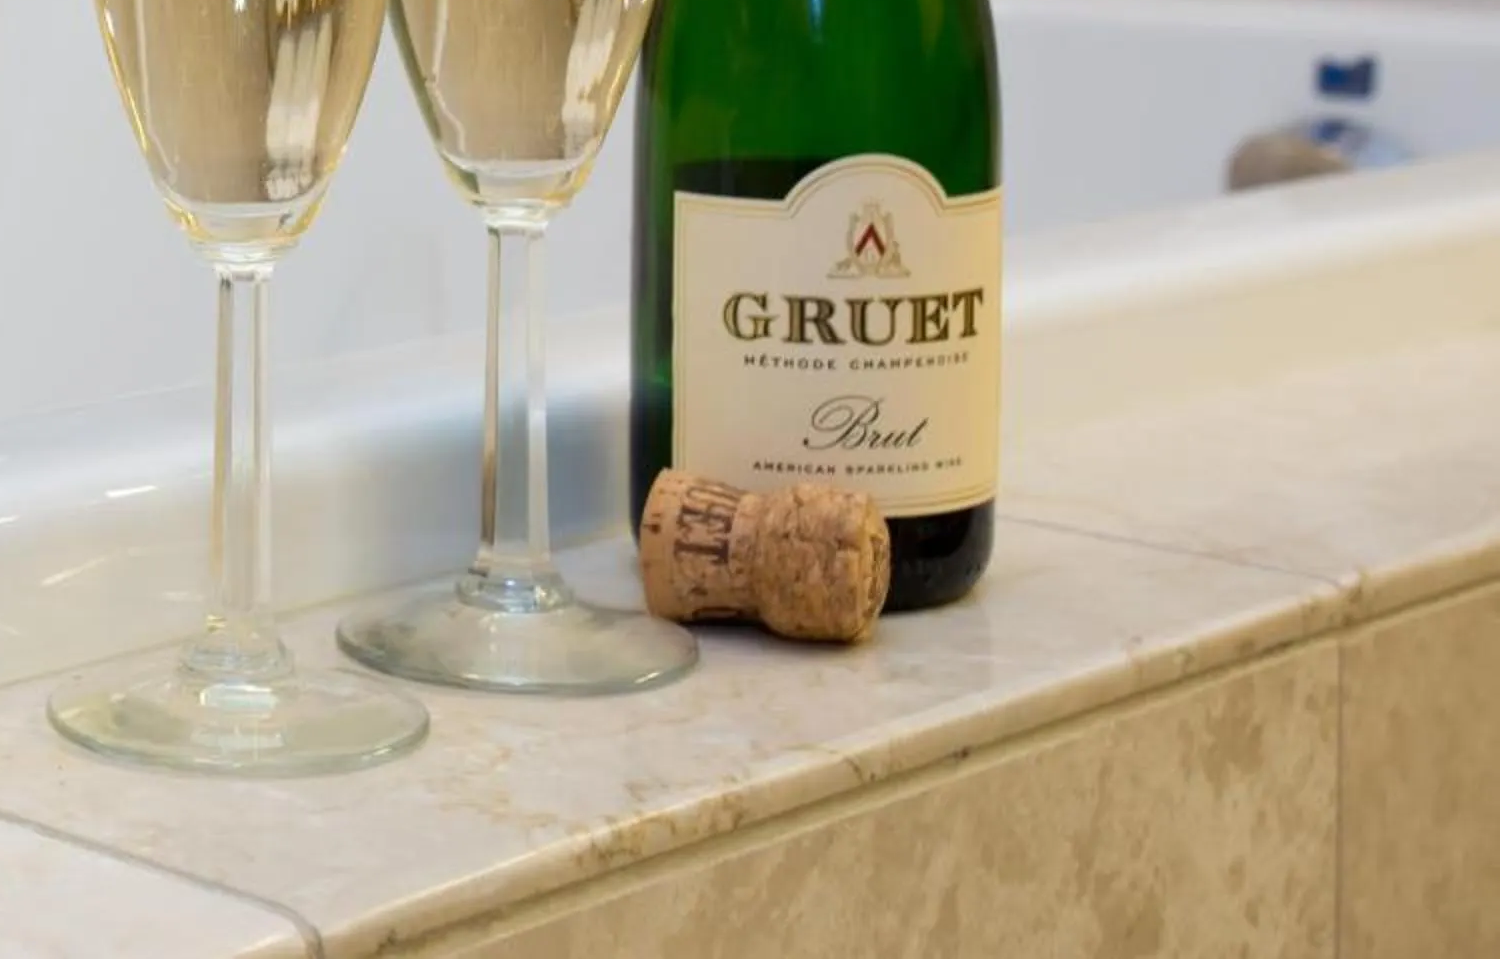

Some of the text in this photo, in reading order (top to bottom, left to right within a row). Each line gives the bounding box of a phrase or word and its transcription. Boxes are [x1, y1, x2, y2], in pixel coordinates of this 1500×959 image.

[722, 287, 985, 347] GRUET
[848, 350, 970, 371] CHAMPENOISE
[802, 394, 930, 451] Brut
[751, 460, 838, 476] AMERICAN
